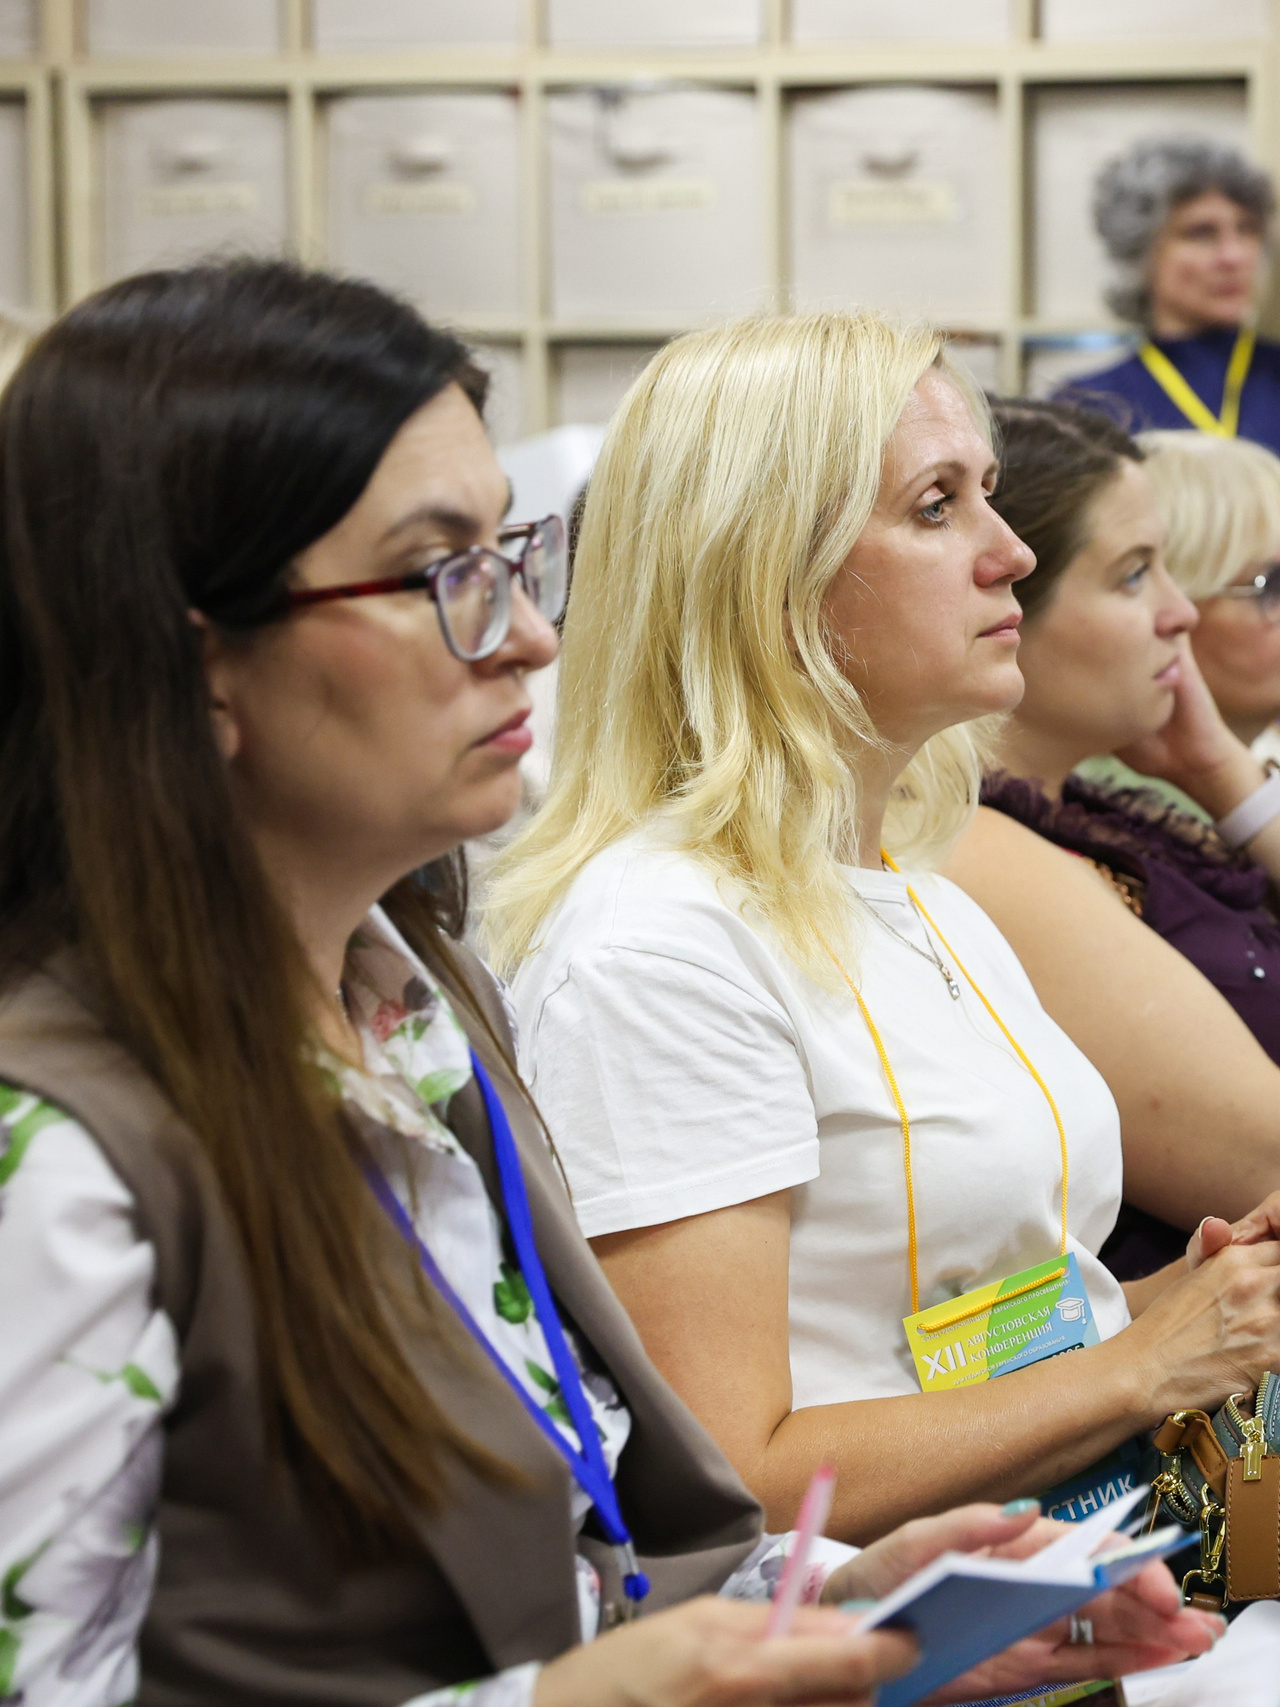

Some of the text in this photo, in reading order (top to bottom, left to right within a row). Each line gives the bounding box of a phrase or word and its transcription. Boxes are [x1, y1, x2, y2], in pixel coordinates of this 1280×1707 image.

[993, 1296, 1027, 1314] ЕВРЕЙСКОГО
[967, 1305, 1051, 1347] АВГУСТОВСКАЯ
[970, 1323, 1053, 1364] КОНФЕРЕНЦИЯ
[920, 1340, 968, 1381] XII
[995, 1352, 1027, 1369] ЕВРЕЙСКОГО
[1028, 1335, 1066, 1357] ОБРАЗОВАНИЯ
